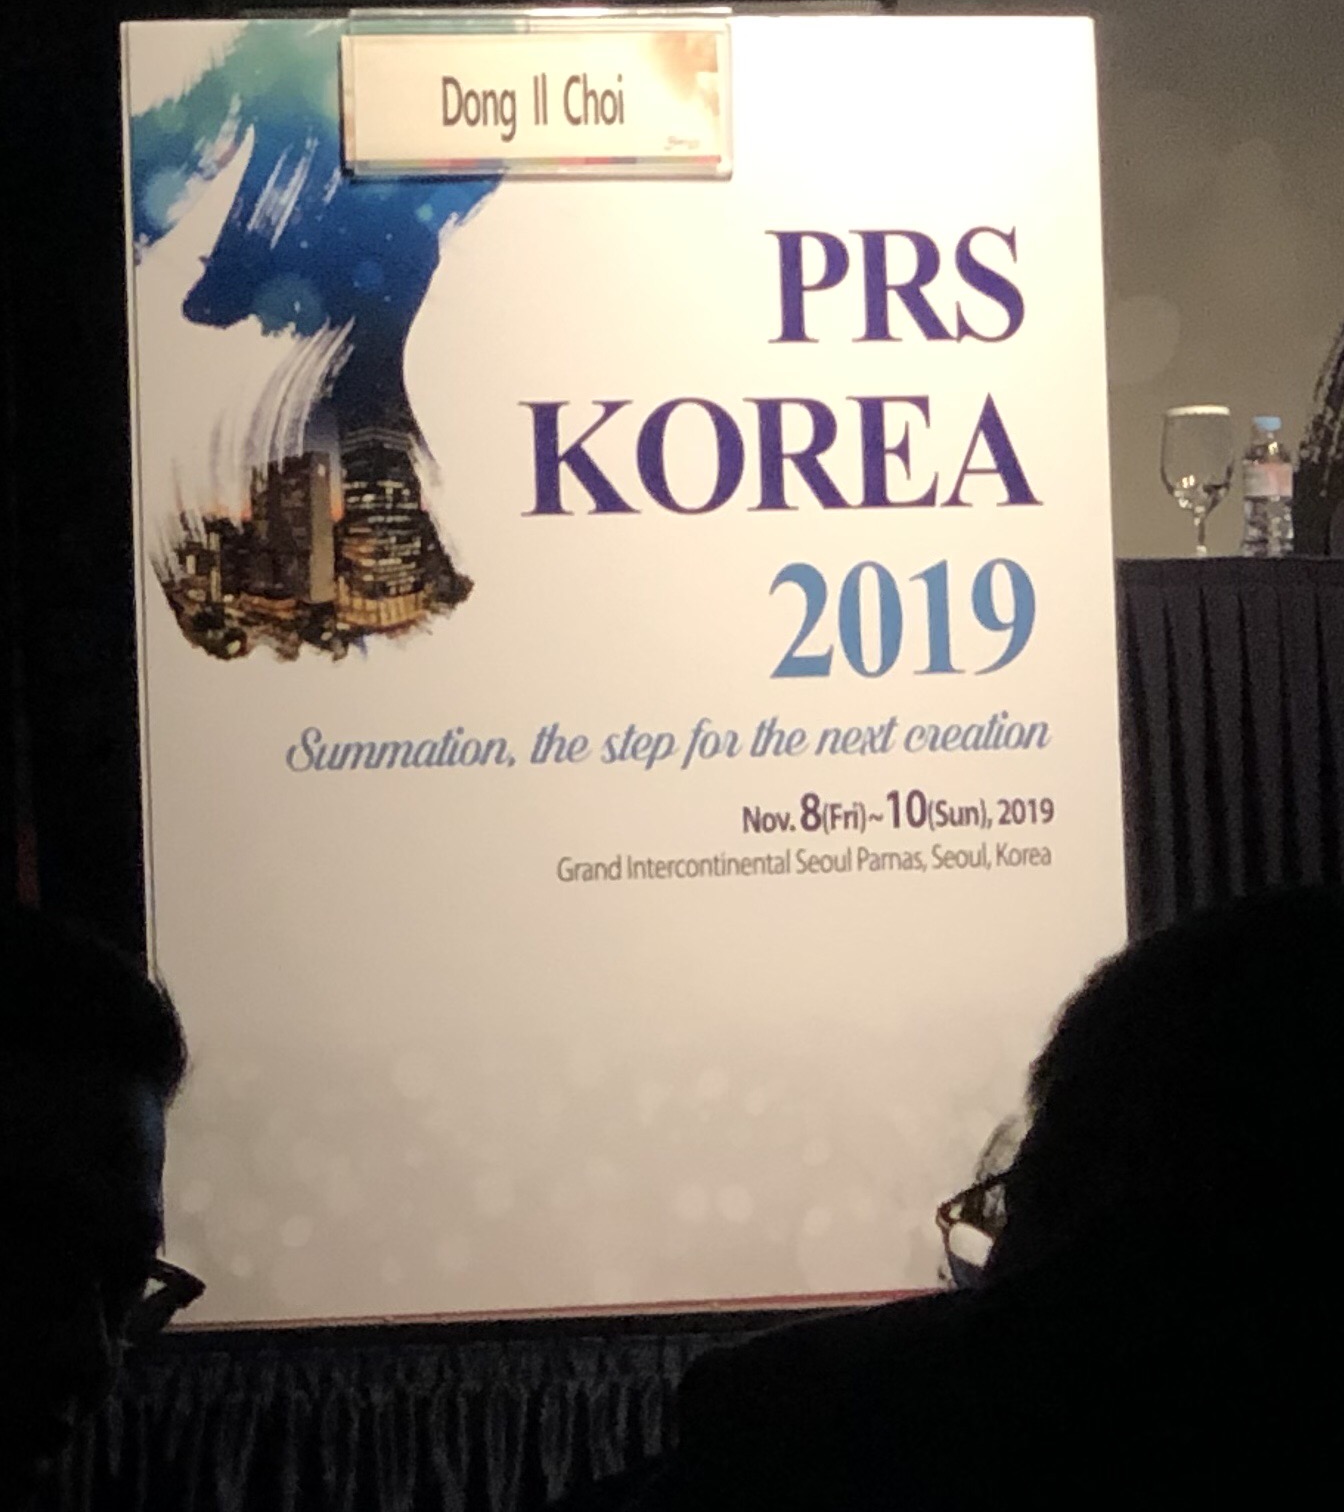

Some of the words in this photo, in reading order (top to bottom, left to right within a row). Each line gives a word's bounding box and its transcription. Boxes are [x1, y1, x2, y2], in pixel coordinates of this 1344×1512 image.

[441, 74, 517, 143] Dong
[562, 72, 625, 126] Choi
[766, 226, 1025, 344] PRS
[517, 392, 1044, 518] KOREA
[769, 557, 1036, 679] 2019
[285, 726, 517, 772] Summation,
[529, 722, 591, 765] the
[601, 723, 680, 772] step
[681, 717, 744, 771] for
[749, 715, 810, 758] the
[814, 715, 899, 756] next
[903, 710, 1052, 753] creation
[742, 806, 796, 834] Nov.
[997, 797, 1055, 826] 2019
[557, 855, 622, 882] Grand
[627, 848, 791, 879] Intercontinental
[795, 846, 852, 874] Seoul
[931, 841, 991, 870] Seoul,
[996, 841, 1052, 867] Korea
